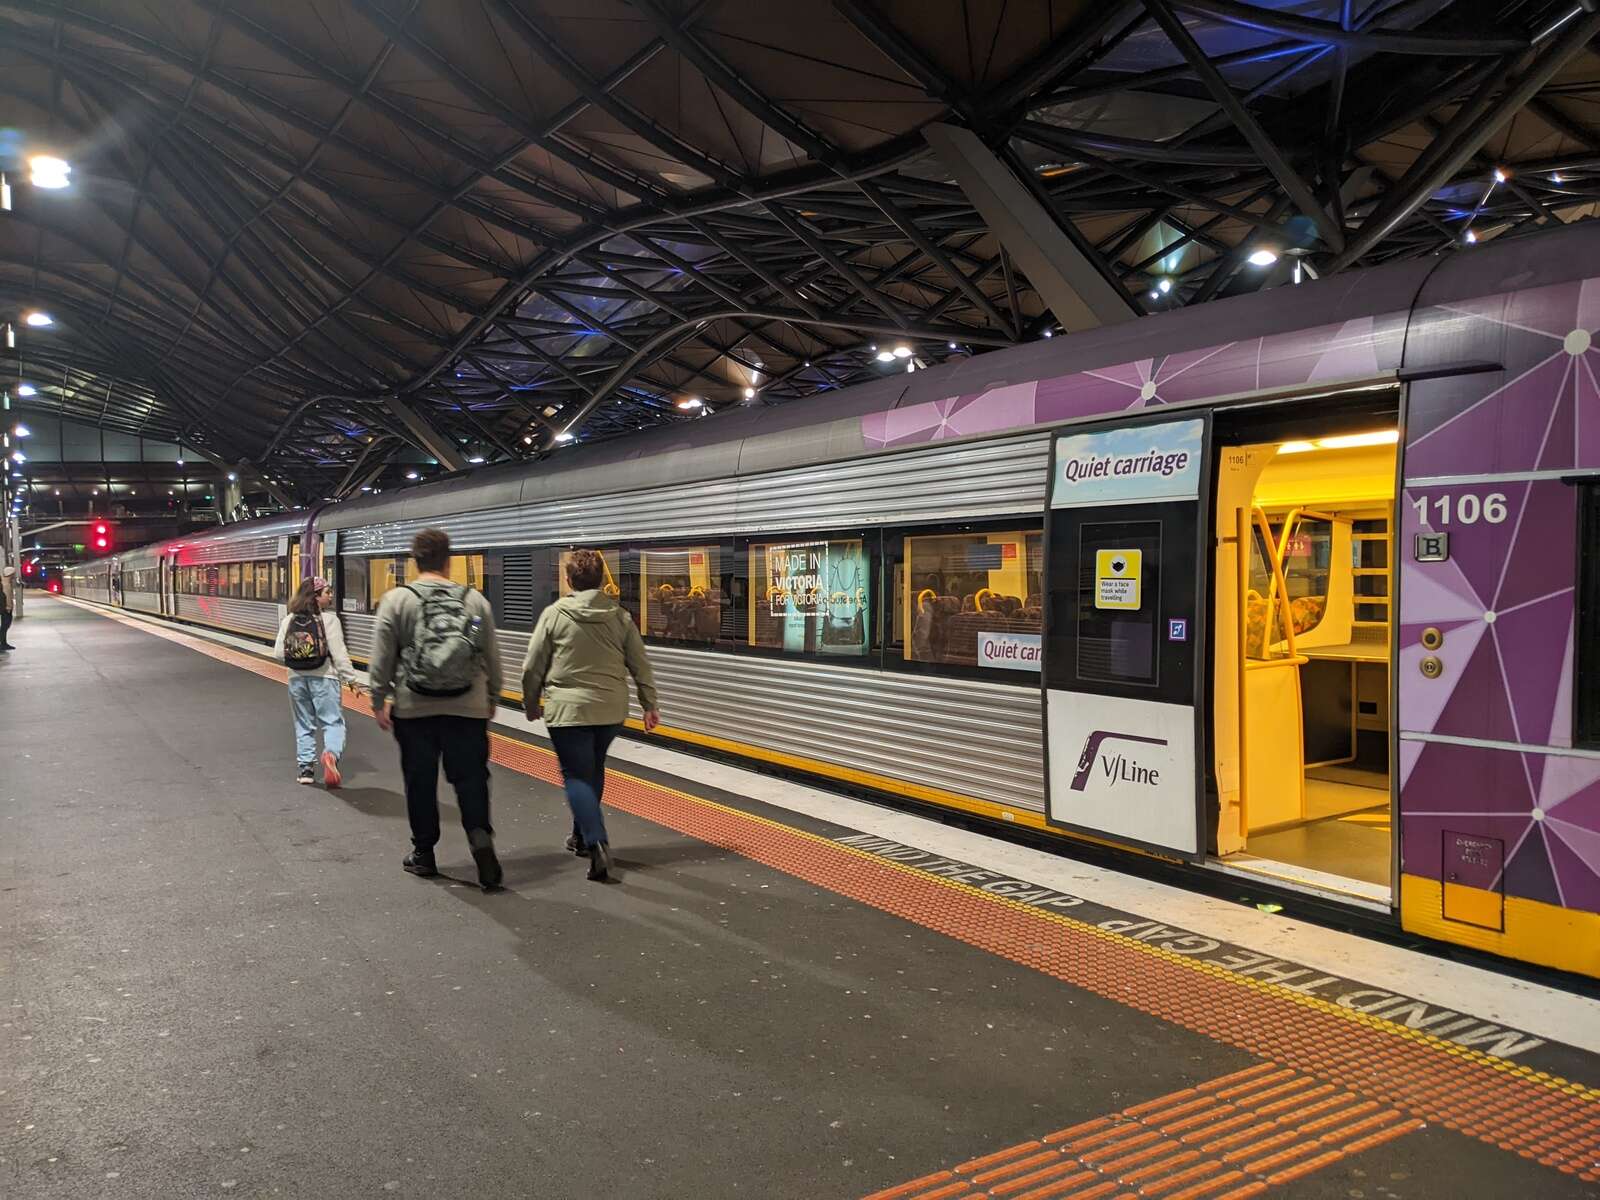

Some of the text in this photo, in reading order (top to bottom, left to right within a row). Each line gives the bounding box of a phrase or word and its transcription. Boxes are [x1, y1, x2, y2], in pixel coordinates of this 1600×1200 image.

[1066, 450, 1188, 482] Quiet carriage
[1413, 493, 1508, 524] 1106
[1422, 537, 1442, 556] B
[775, 552, 821, 573] MADE IN
[775, 574, 823, 591] VICTORIA
[984, 640, 1018, 659] Quiet
[1102, 754, 1159, 787] V/Line
[834, 834, 1085, 907] MIND THE GAP
[1098, 920, 1547, 1058] MIND THE GAP
